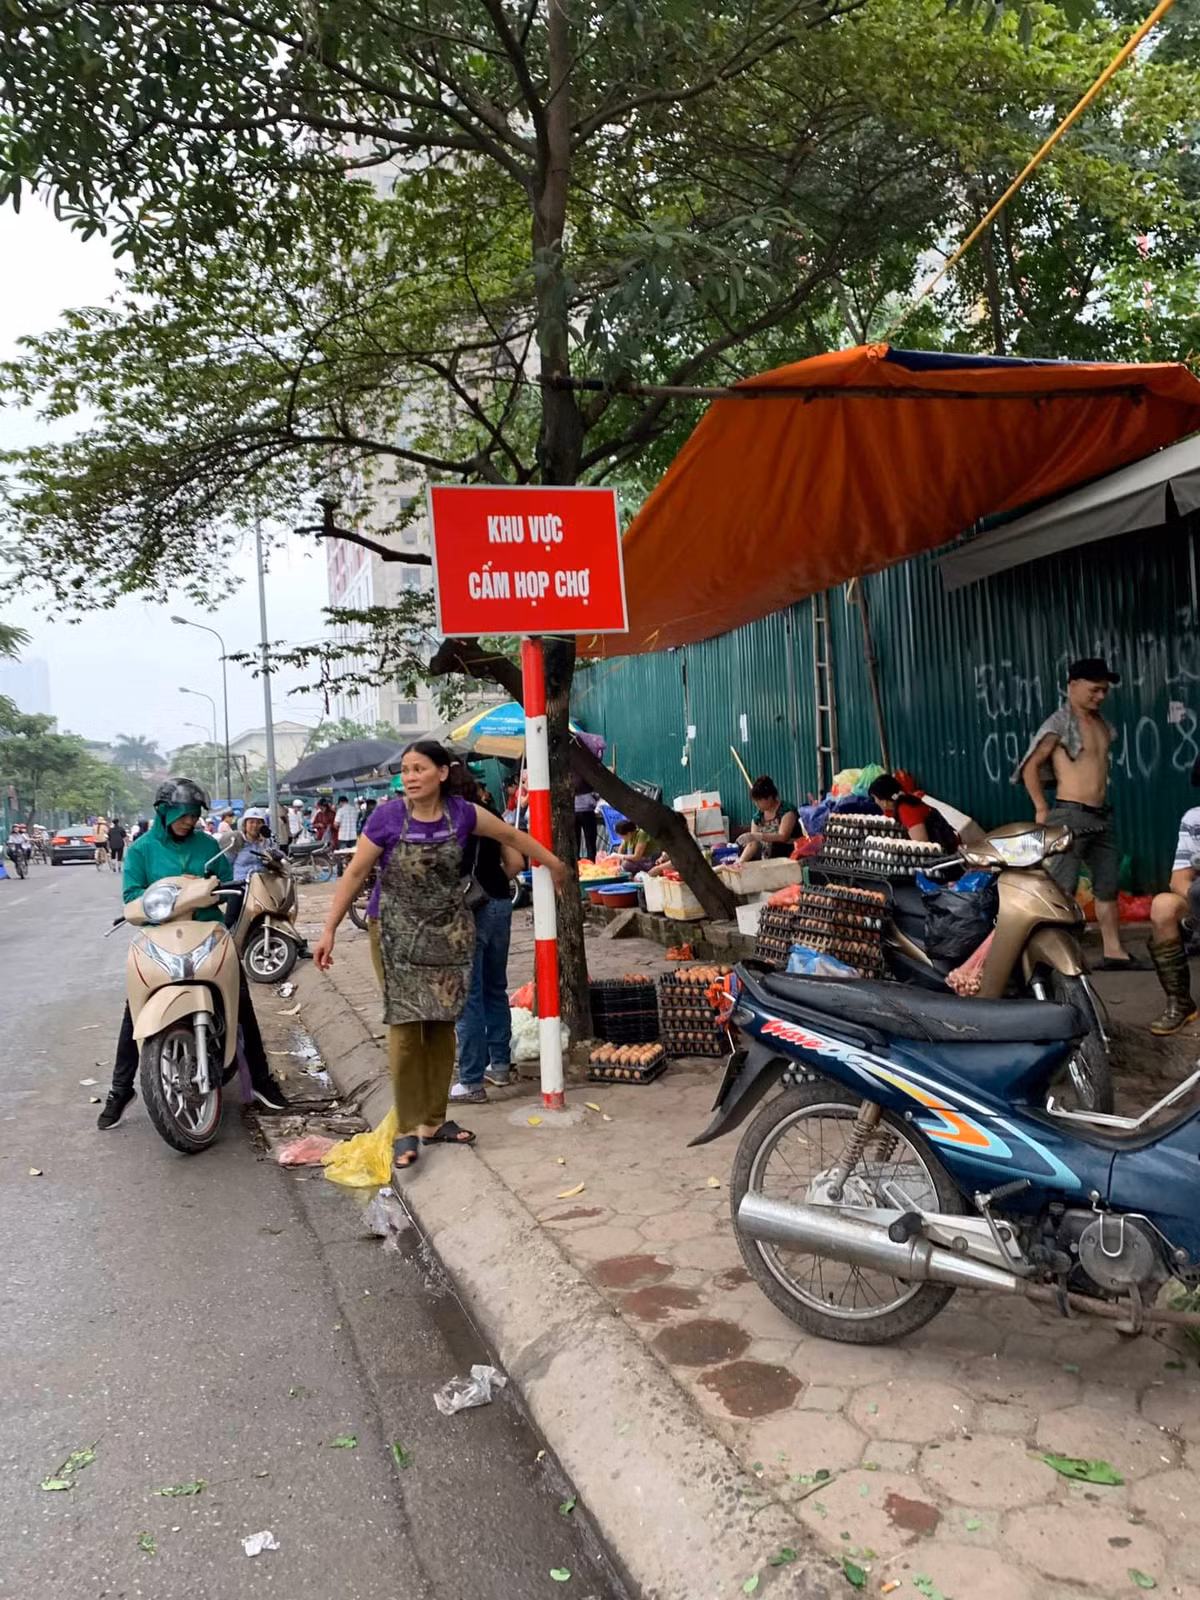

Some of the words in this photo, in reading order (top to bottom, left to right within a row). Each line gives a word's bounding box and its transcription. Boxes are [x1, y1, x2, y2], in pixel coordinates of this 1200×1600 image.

[486, 515, 525, 543] KHU
[527, 513, 564, 552] VỰC
[468, 560, 511, 600] CẤM
[514, 570, 550, 607] HỌP
[554, 568, 590, 606] CHỢ
[760, 1018, 826, 1050] Wave
